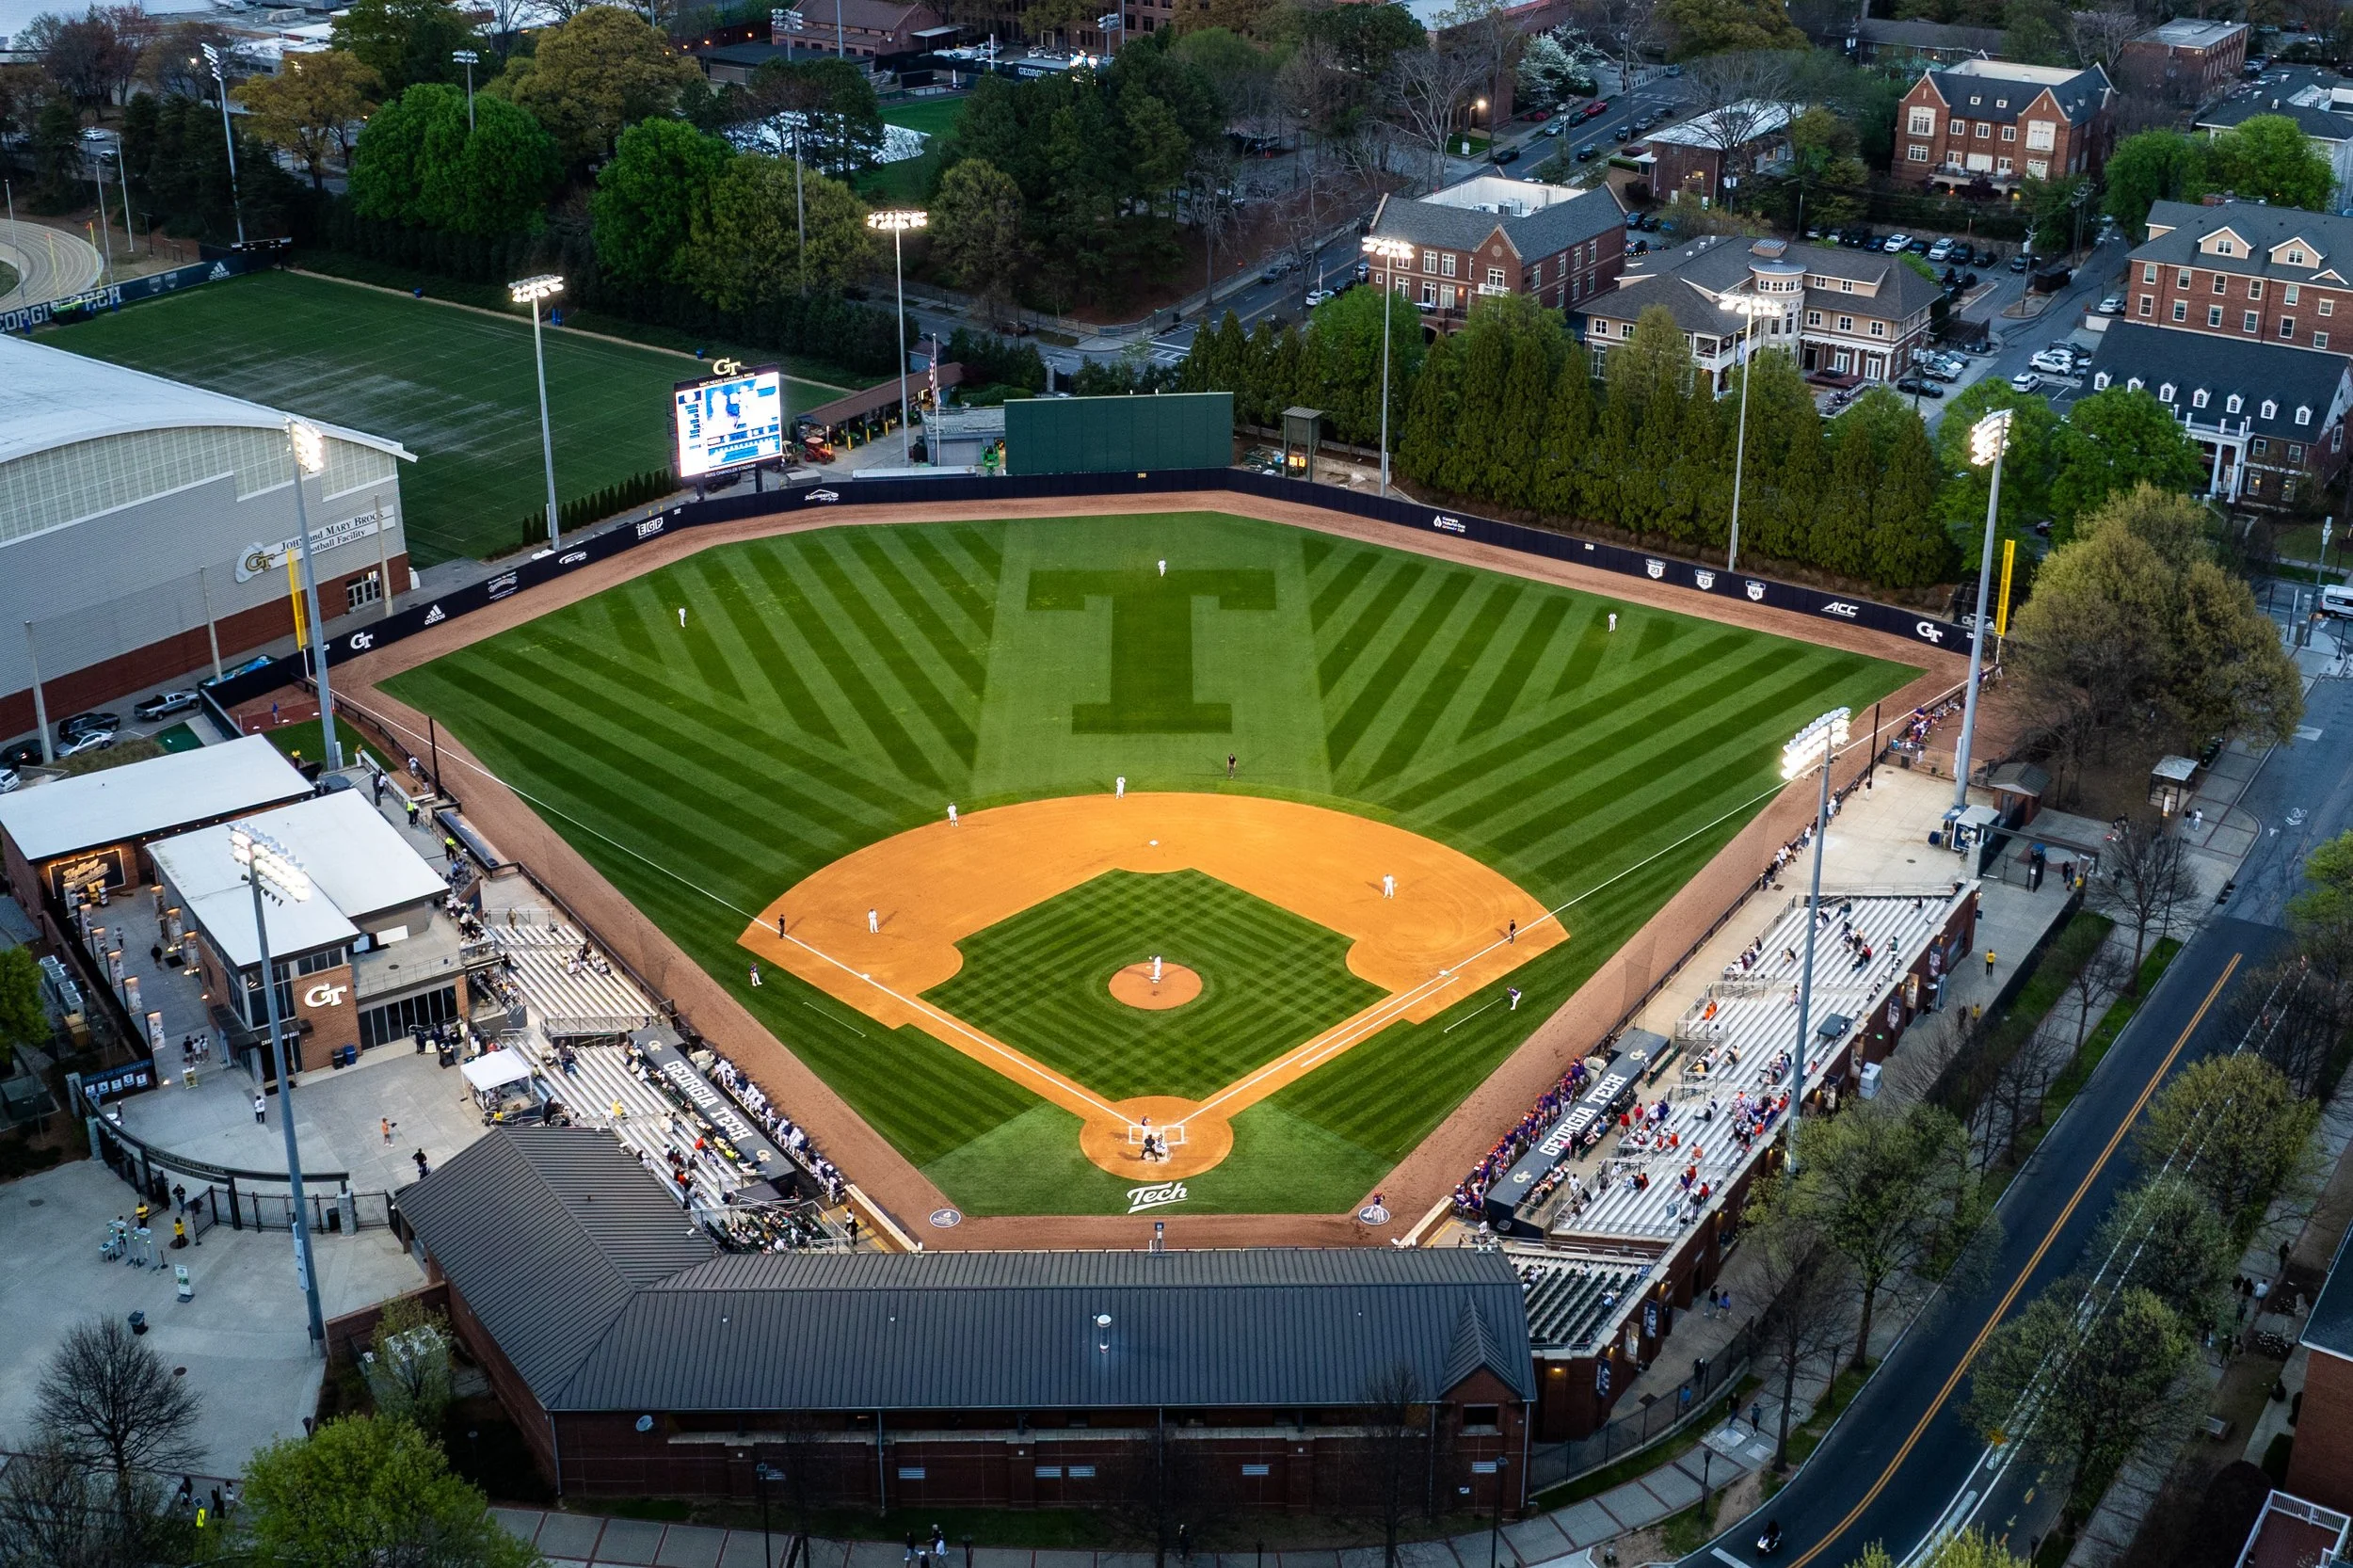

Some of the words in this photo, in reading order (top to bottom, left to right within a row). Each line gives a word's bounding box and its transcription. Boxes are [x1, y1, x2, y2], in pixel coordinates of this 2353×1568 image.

[1018, 67, 1047, 77] GEORG
[713, 358, 741, 376] GT
[326, 520, 352, 536] MARY
[337, 530, 366, 544] Facility
[246, 551, 275, 572] GT
[1823, 601, 1859, 616] ACC
[350, 632, 374, 649] GT
[1916, 621, 1943, 643] GT
[304, 983, 347, 1008] GT
[663, 1060, 720, 1109] GEORGIA
[710, 1106, 753, 1142] TECH
[1538, 1106, 1598, 1157] GEORGIA
[1585, 1072, 1627, 1106] TECH
[1127, 1181, 1188, 1208] Tech
